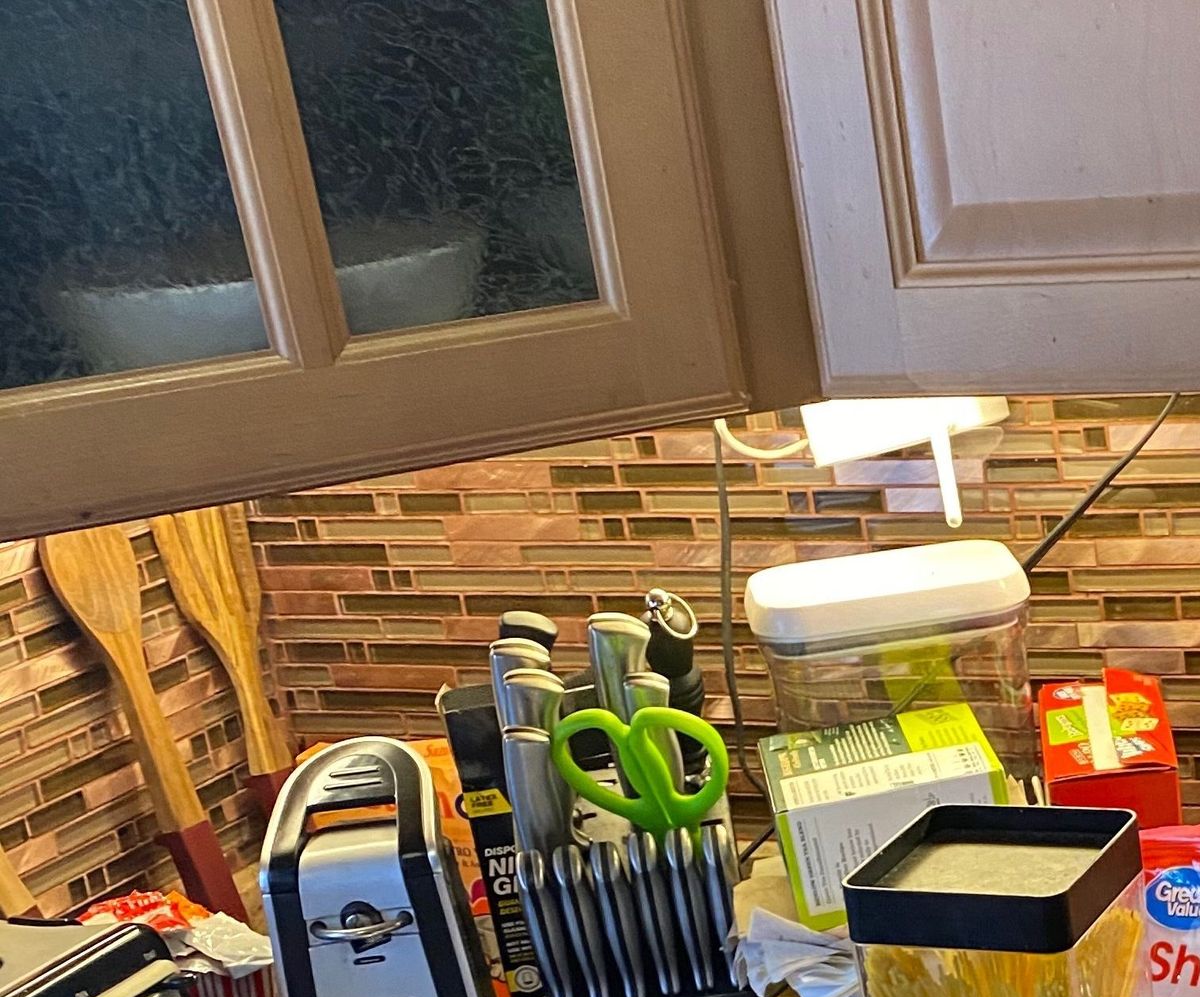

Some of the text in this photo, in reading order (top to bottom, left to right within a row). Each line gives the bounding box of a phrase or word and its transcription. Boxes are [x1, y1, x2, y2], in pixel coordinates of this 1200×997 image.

[469, 793, 497, 802] LATEX
[471, 800, 494, 808] FREE
[484, 844, 516, 857] DISPO
[489, 856, 514, 877] NI
